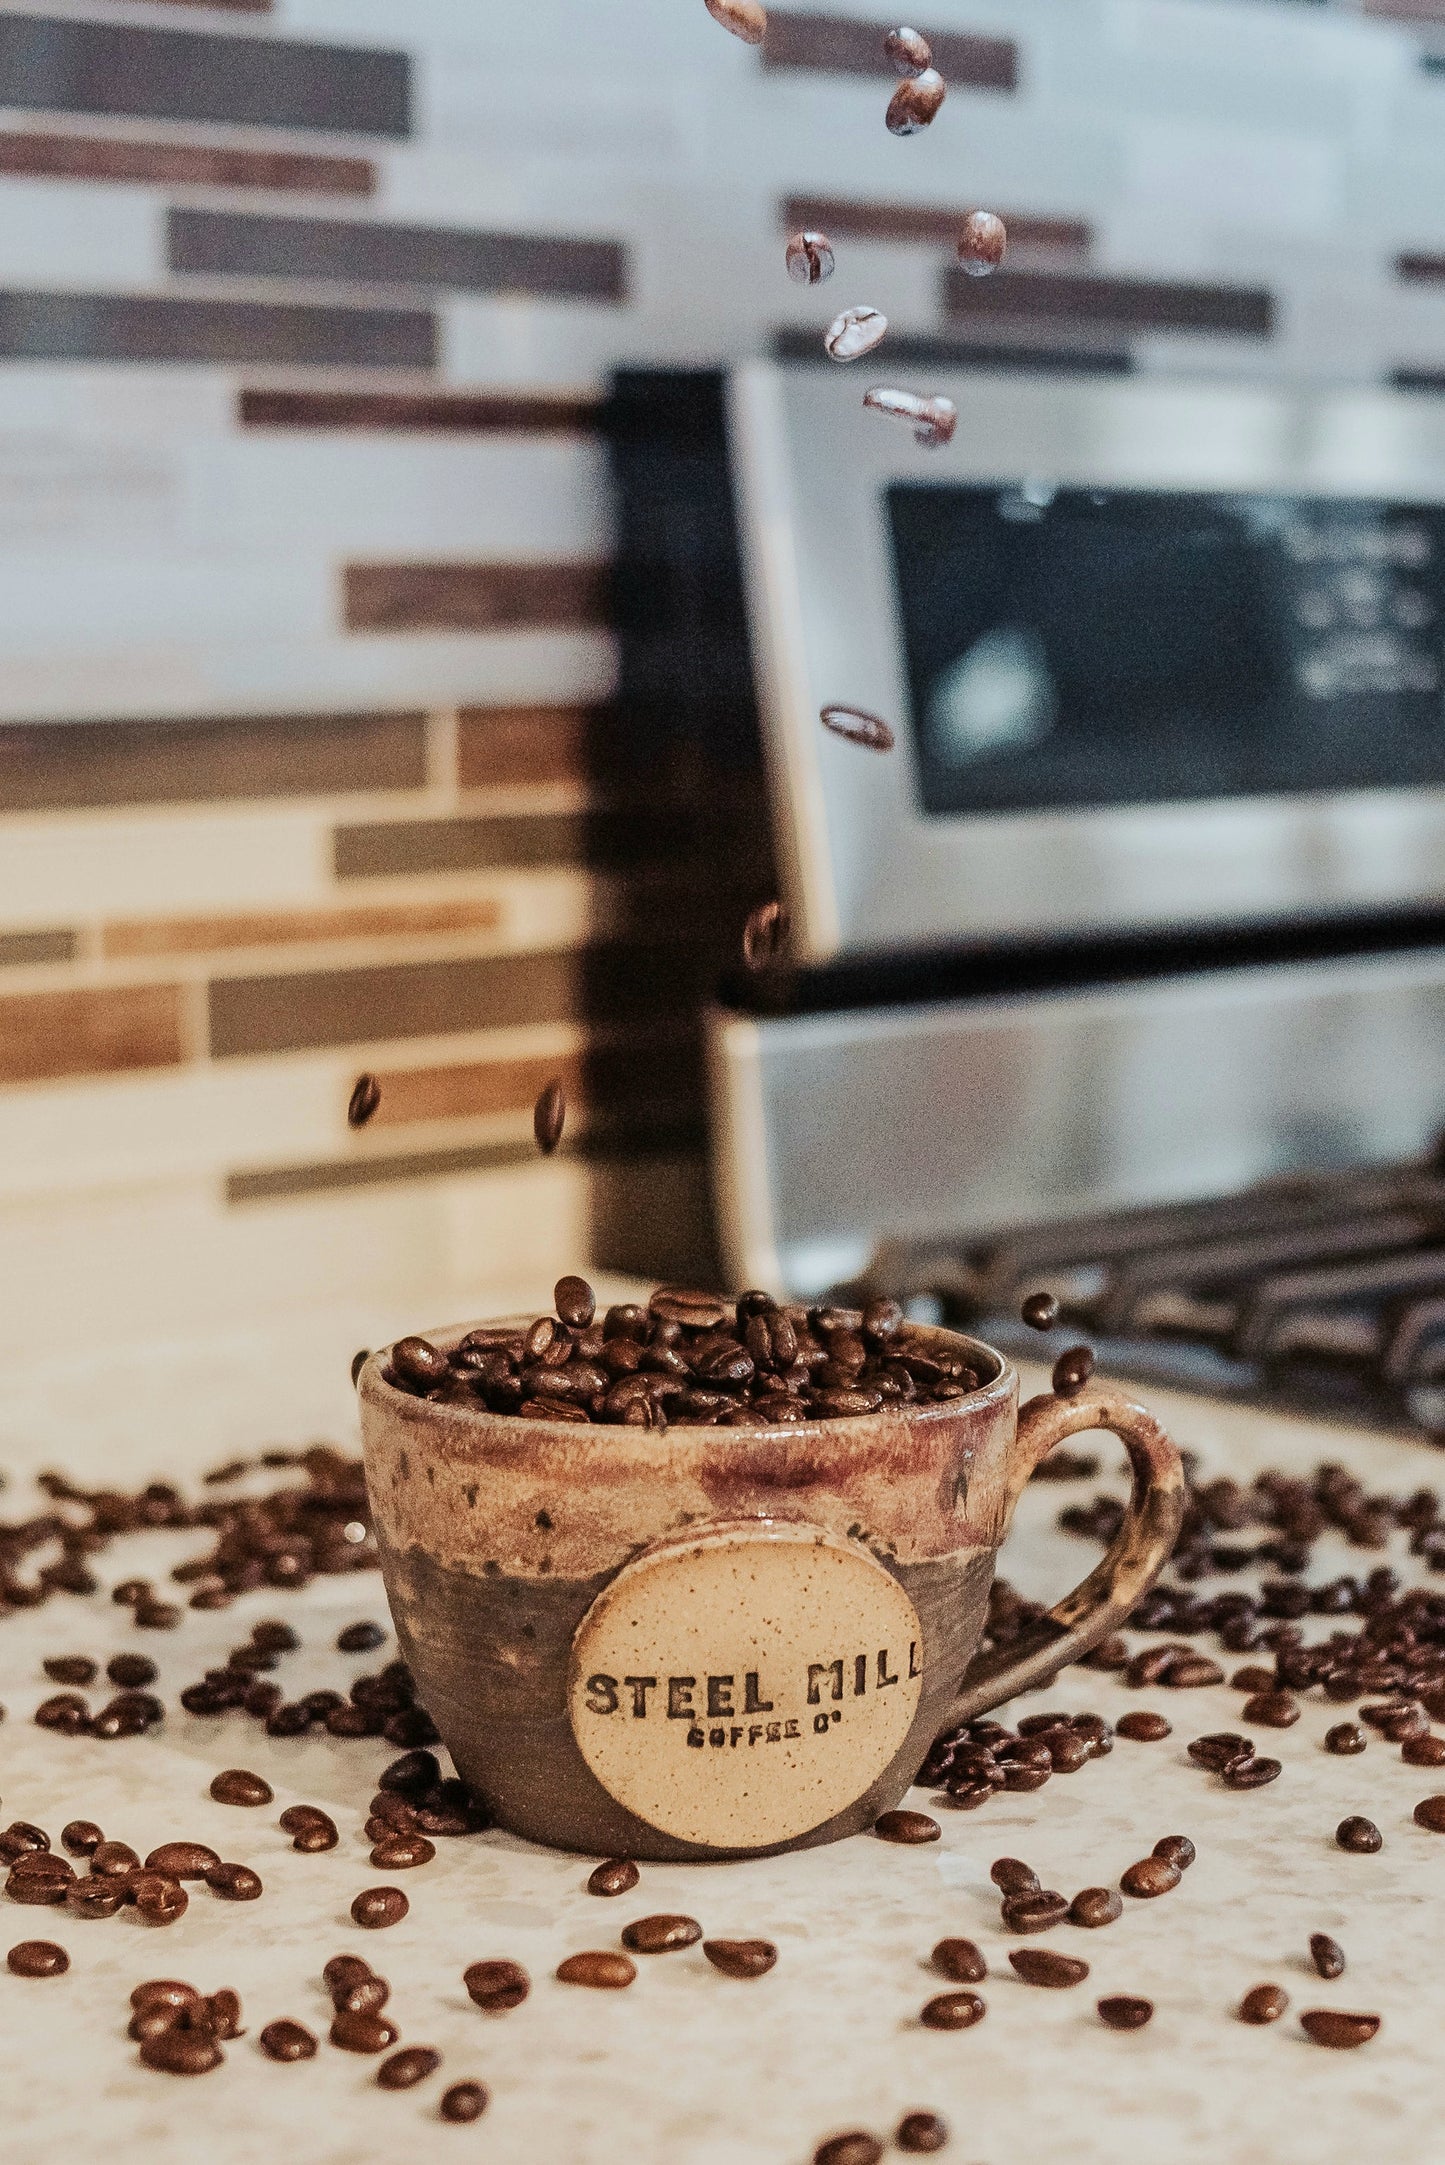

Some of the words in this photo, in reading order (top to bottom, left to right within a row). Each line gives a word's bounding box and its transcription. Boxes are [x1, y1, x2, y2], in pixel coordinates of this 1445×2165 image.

[585, 1671, 774, 1720] STEEL
[806, 1640, 921, 1705] MILL
[687, 1718, 801, 1748] COFFEE
